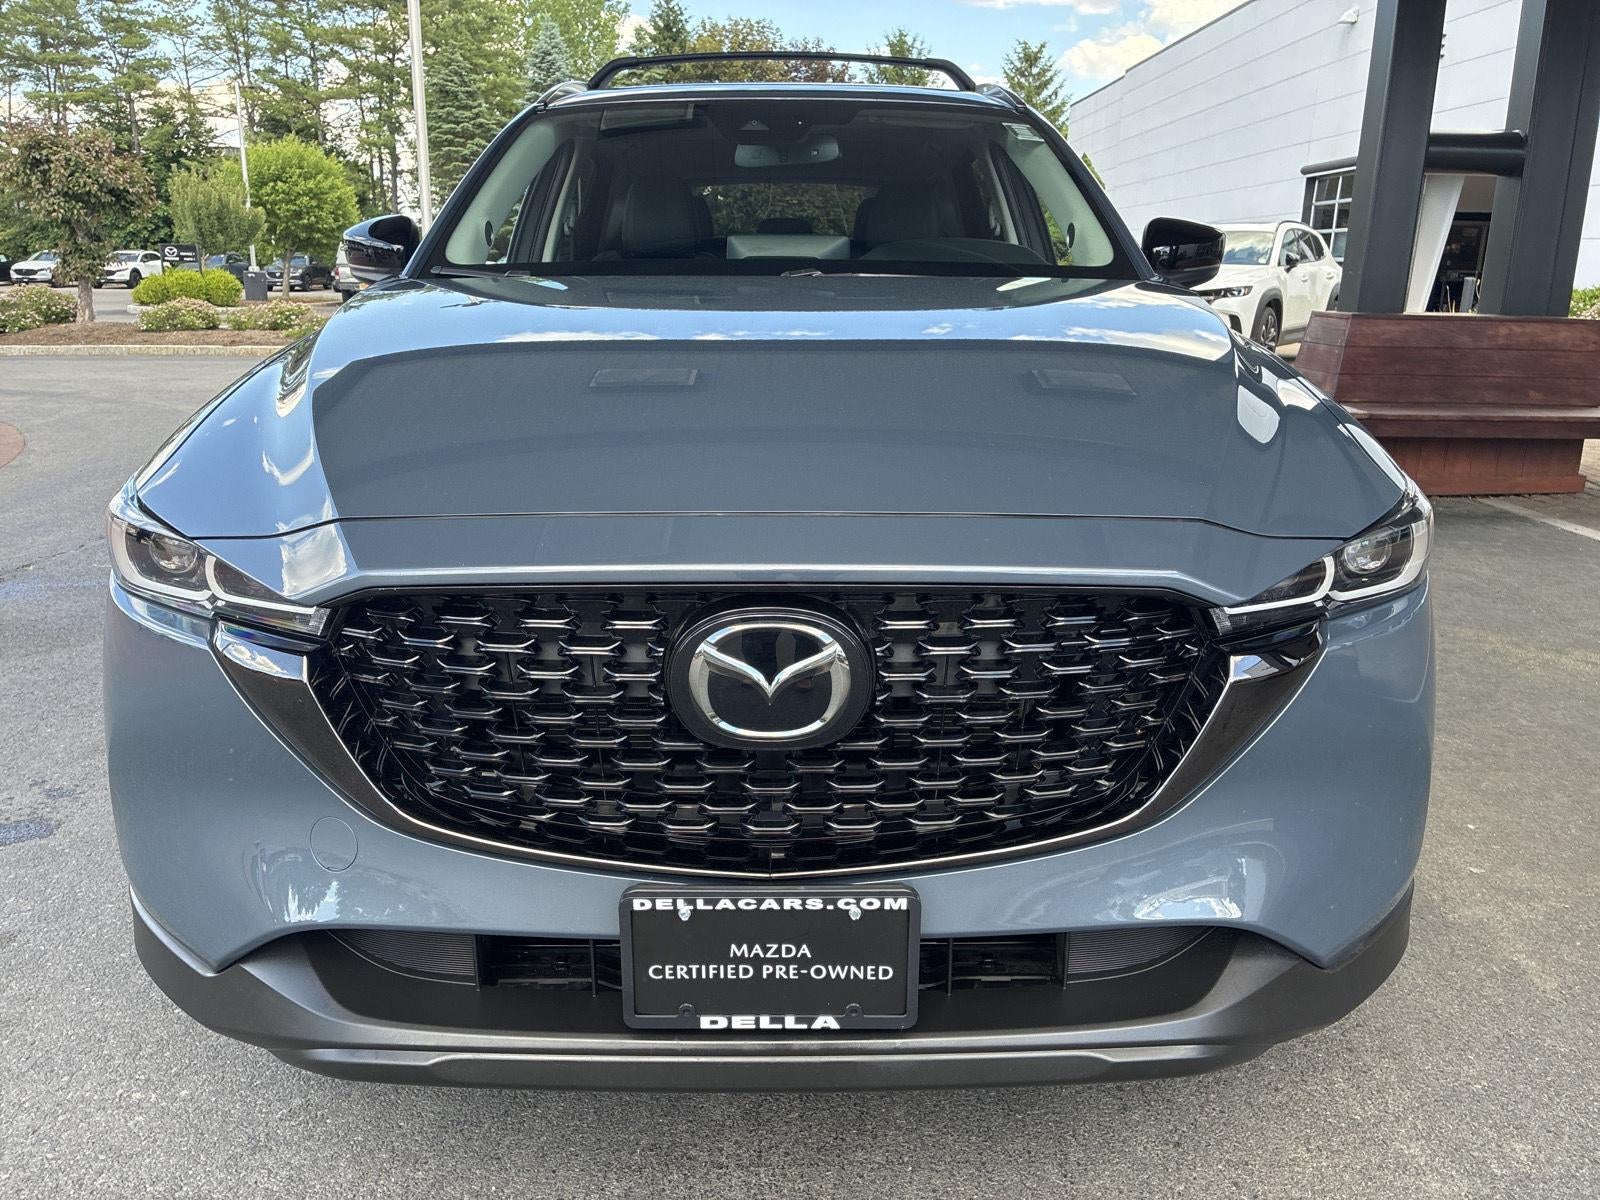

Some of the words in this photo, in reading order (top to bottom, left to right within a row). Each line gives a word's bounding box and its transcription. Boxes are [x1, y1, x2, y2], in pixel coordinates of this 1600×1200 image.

[632, 897, 908, 911] DELLACARS.COM
[730, 943, 812, 958] MAZDA
[648, 964, 754, 980] CERTIFIED
[762, 964, 894, 980] PRE-OWNED
[699, 1014, 841, 1030] DELLA
